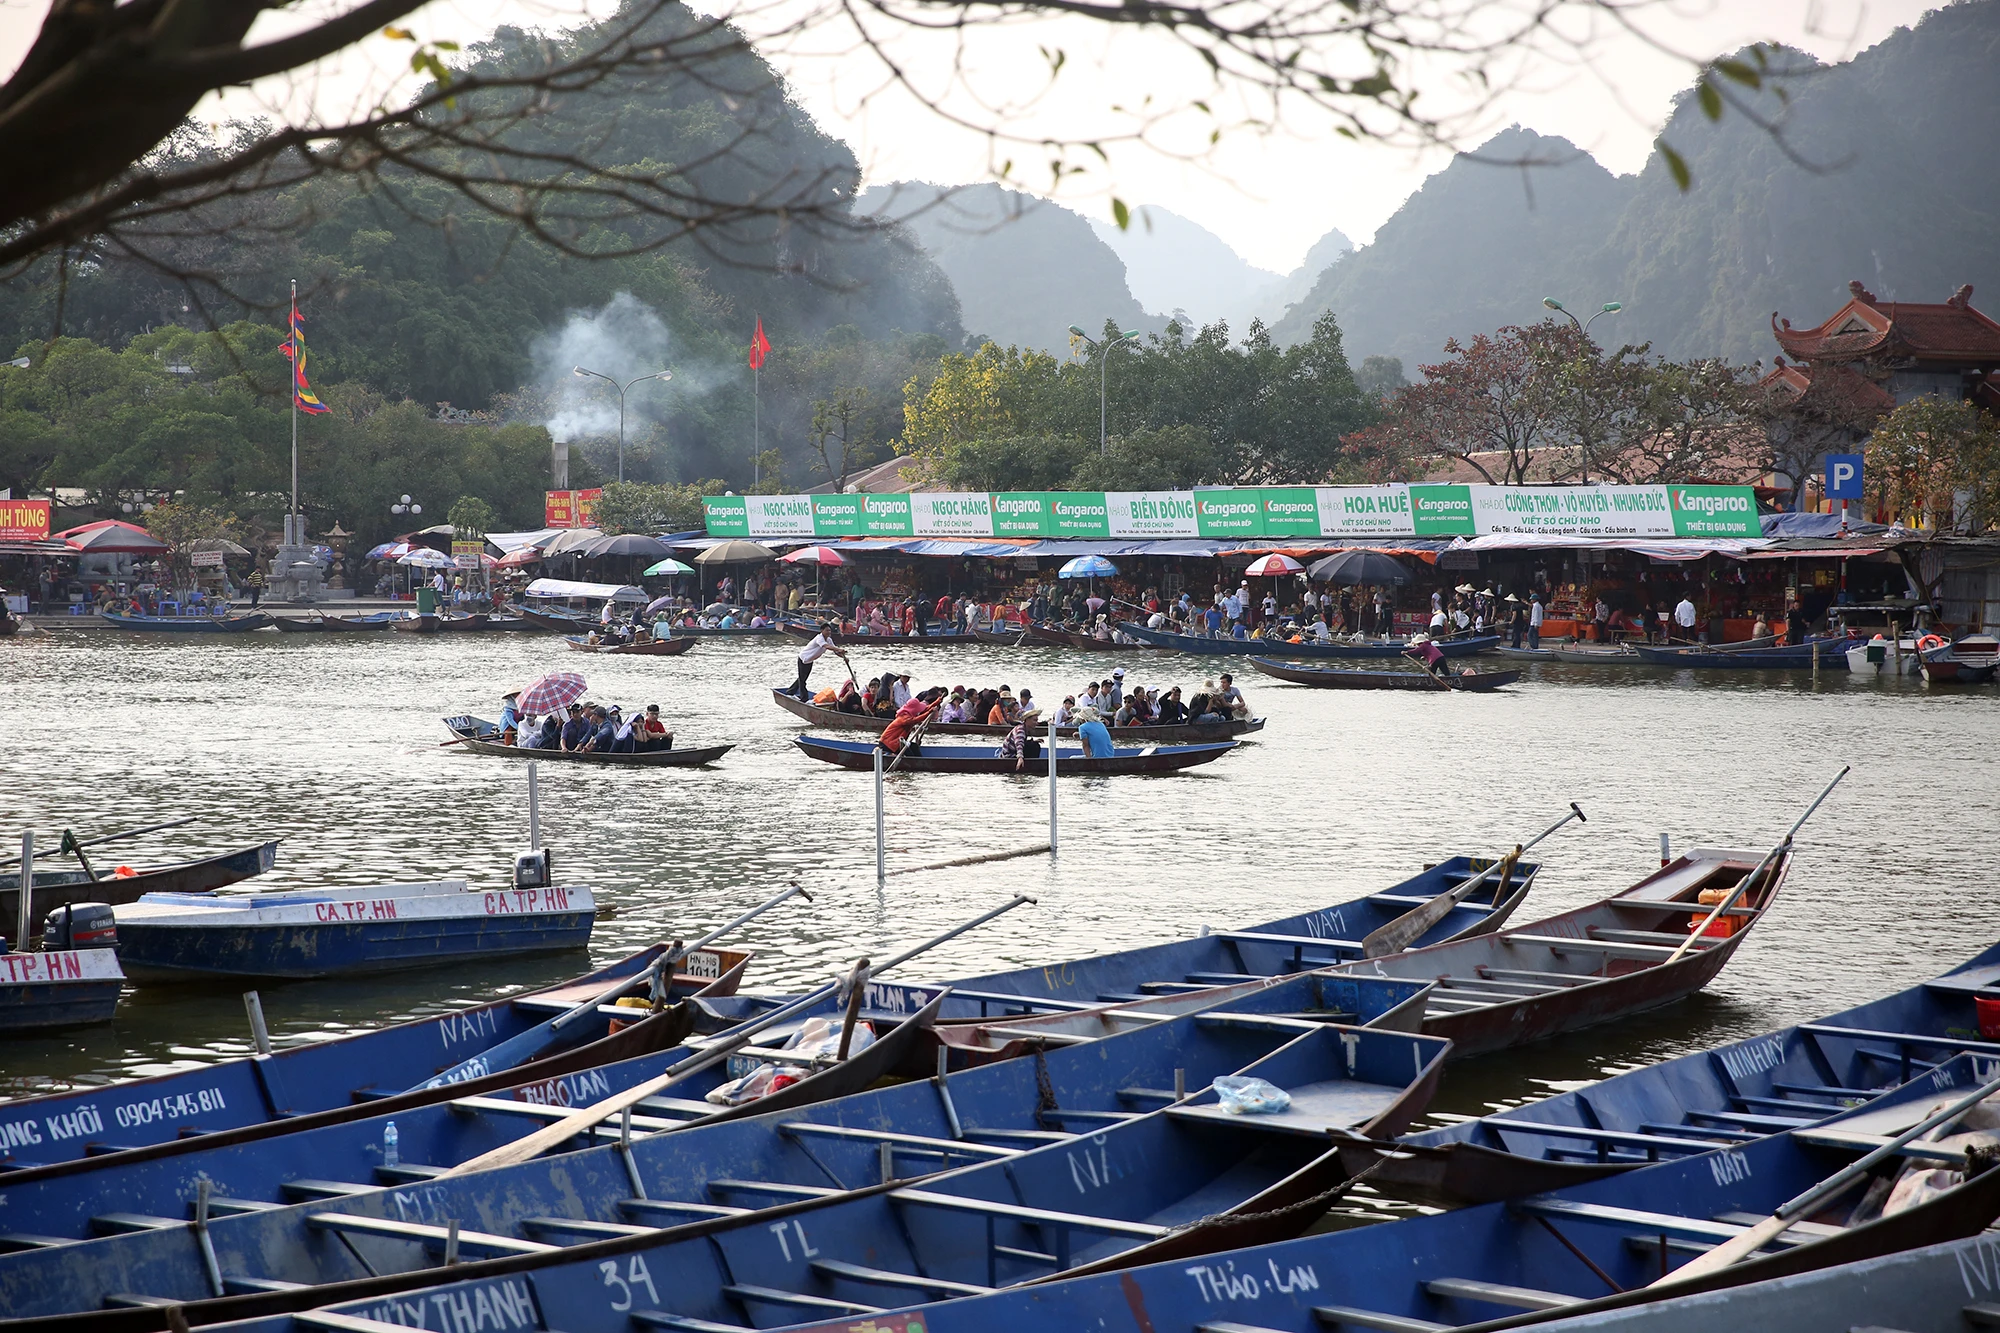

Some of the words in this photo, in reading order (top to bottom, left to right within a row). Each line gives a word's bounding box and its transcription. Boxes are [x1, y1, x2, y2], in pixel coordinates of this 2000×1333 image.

[1834, 463, 1854, 490] P
[763, 502, 786, 519] NGỌC
[932, 501, 960, 519] NGỌC
[1130, 494, 1158, 519] BIỂN
[1160, 496, 1194, 519] ĐÔNG
[1344, 496, 1374, 514] HOA
[1378, 491, 1409, 516] HUỆ
[1414, 498, 1468, 512] Kangaroo
[1505, 489, 1534, 512] CƯỜNG
[1534, 493, 1560, 512] THƠM
[1612, 494, 1646, 512] NHUNG
[1646, 488, 1666, 512] ĐỨC
[1672, 490, 1748, 516] Kangaroo
[14, 504, 46, 528] TÙNG
[1000, 520, 1012, 530] THIẾT
[1012, 522, 1018, 532] BỊ
[1018, 522, 1026, 530] GIA
[1026, 522, 1039, 532] DỤNG
[1060, 520, 1073, 528] THIẾT
[1208, 520, 1222, 528] THIẾT
[1229, 519, 1240, 527] NHÀ
[1242, 518, 1252, 526] BẾP
[1522, 515, 1542, 524] VIẾT
[1558, 516, 1578, 524] CHỮ
[1580, 516, 1600, 524] NHO
[1686, 520, 1706, 530] THIẾT
[1706, 523, 1714, 533] BỊ
[1714, 523, 1726, 532] GIA
[1727, 523, 1746, 534] DỤNG
[315, 900, 396, 922] CA.TP.HN
[484, 887, 568, 914] CA.TP.HN
[46, 926, 56, 934] 25
[690, 954, 700, 964] HN
[690, 965, 716, 978] 1011
[46, 1104, 104, 1141] KHÔI
[770, 1220, 819, 1263] TL
[599, 1254, 660, 1311] 34
[430, 1280, 538, 1333] THANH
